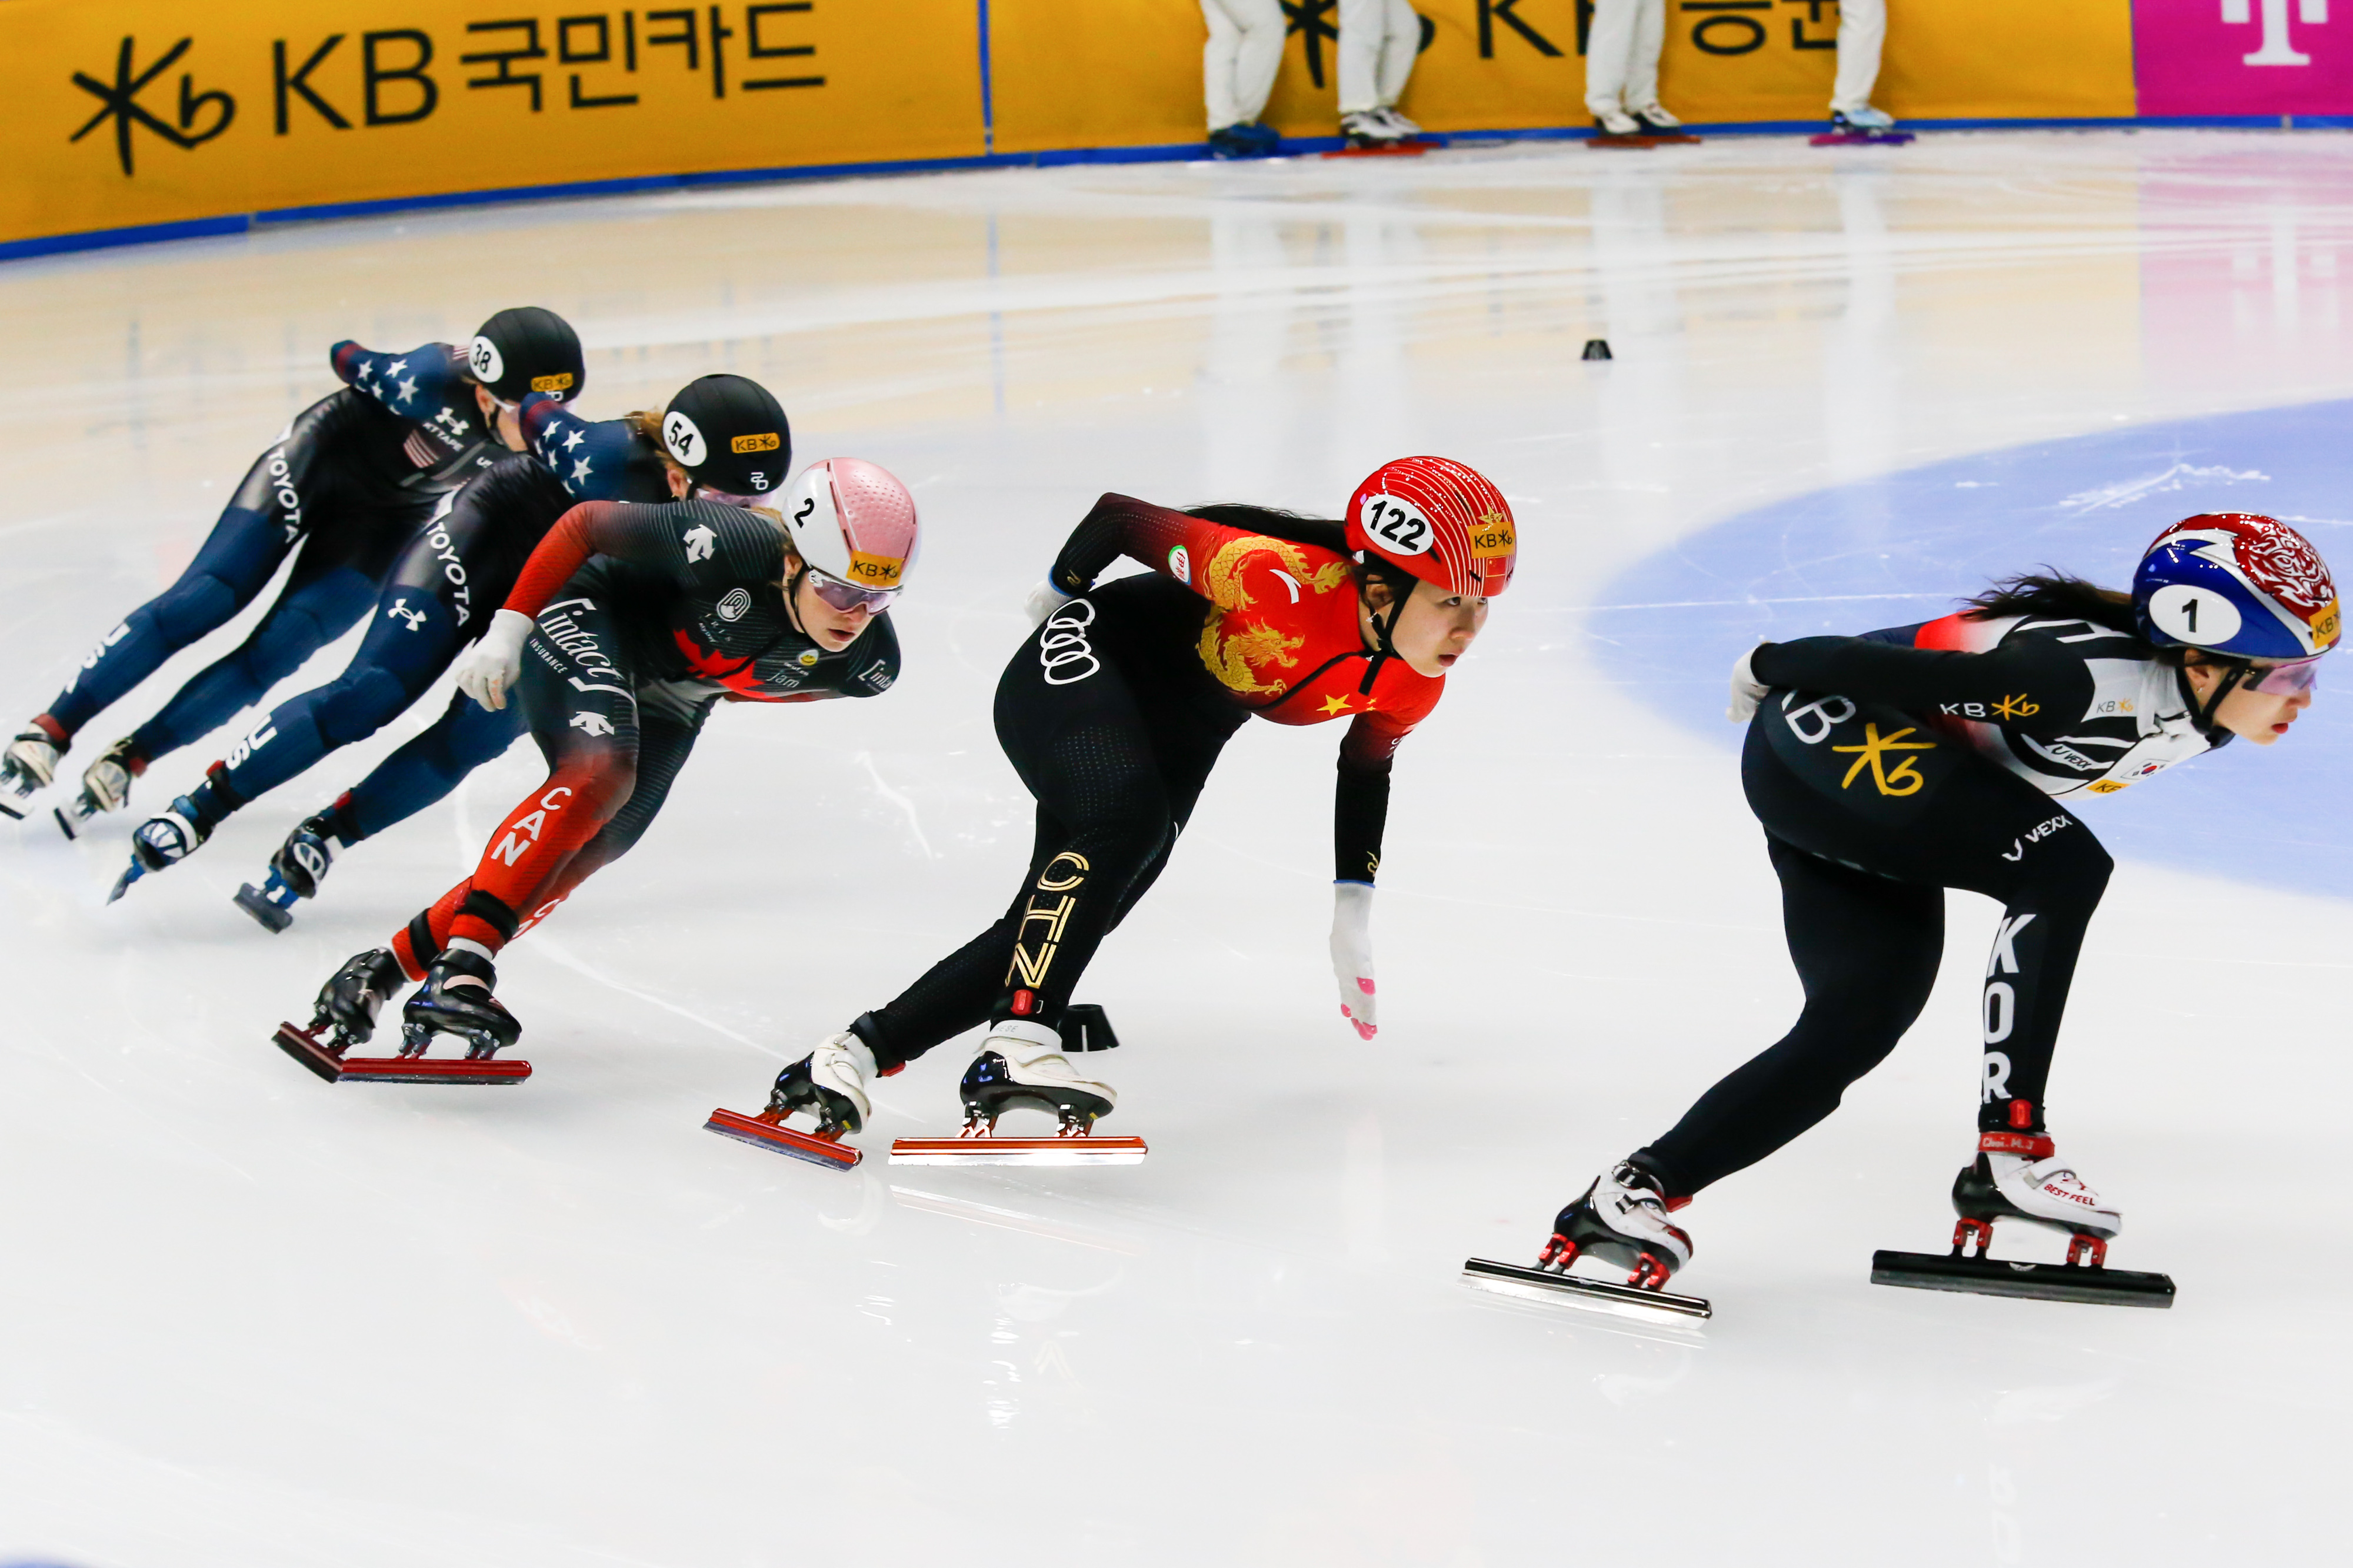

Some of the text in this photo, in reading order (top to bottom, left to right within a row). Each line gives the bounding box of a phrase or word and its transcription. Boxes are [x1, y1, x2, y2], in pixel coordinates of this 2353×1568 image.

[1477, 0, 1590, 58] K
[272, 29, 440, 136] KB
[460, 2, 826, 112] 국민카드
[472, 343, 491, 373] 38
[669, 420, 694, 456] 54
[735, 439, 757, 451] KB
[268, 447, 301, 544] TOYOTA
[794, 498, 815, 529] 2
[1369, 500, 1426, 552] 122
[1474, 533, 1497, 549] KB
[426, 521, 470, 628] TOYOTA
[852, 561, 878, 577] KB
[2182, 598, 2198, 633] 1
[2316, 618, 2334, 639] KB
[529, 638, 568, 673] INSURANCE
[1781, 689, 1857, 745] B
[1939, 702, 1987, 718] KB
[2096, 700, 2116, 714] KB
[491, 786, 572, 868] CAN
[2024, 815, 2074, 843] VEXX
[1005, 850, 1089, 989] CHN
[1982, 913, 2037, 1104] KOR
[2044, 1183, 2095, 1206] BEST FEEL
